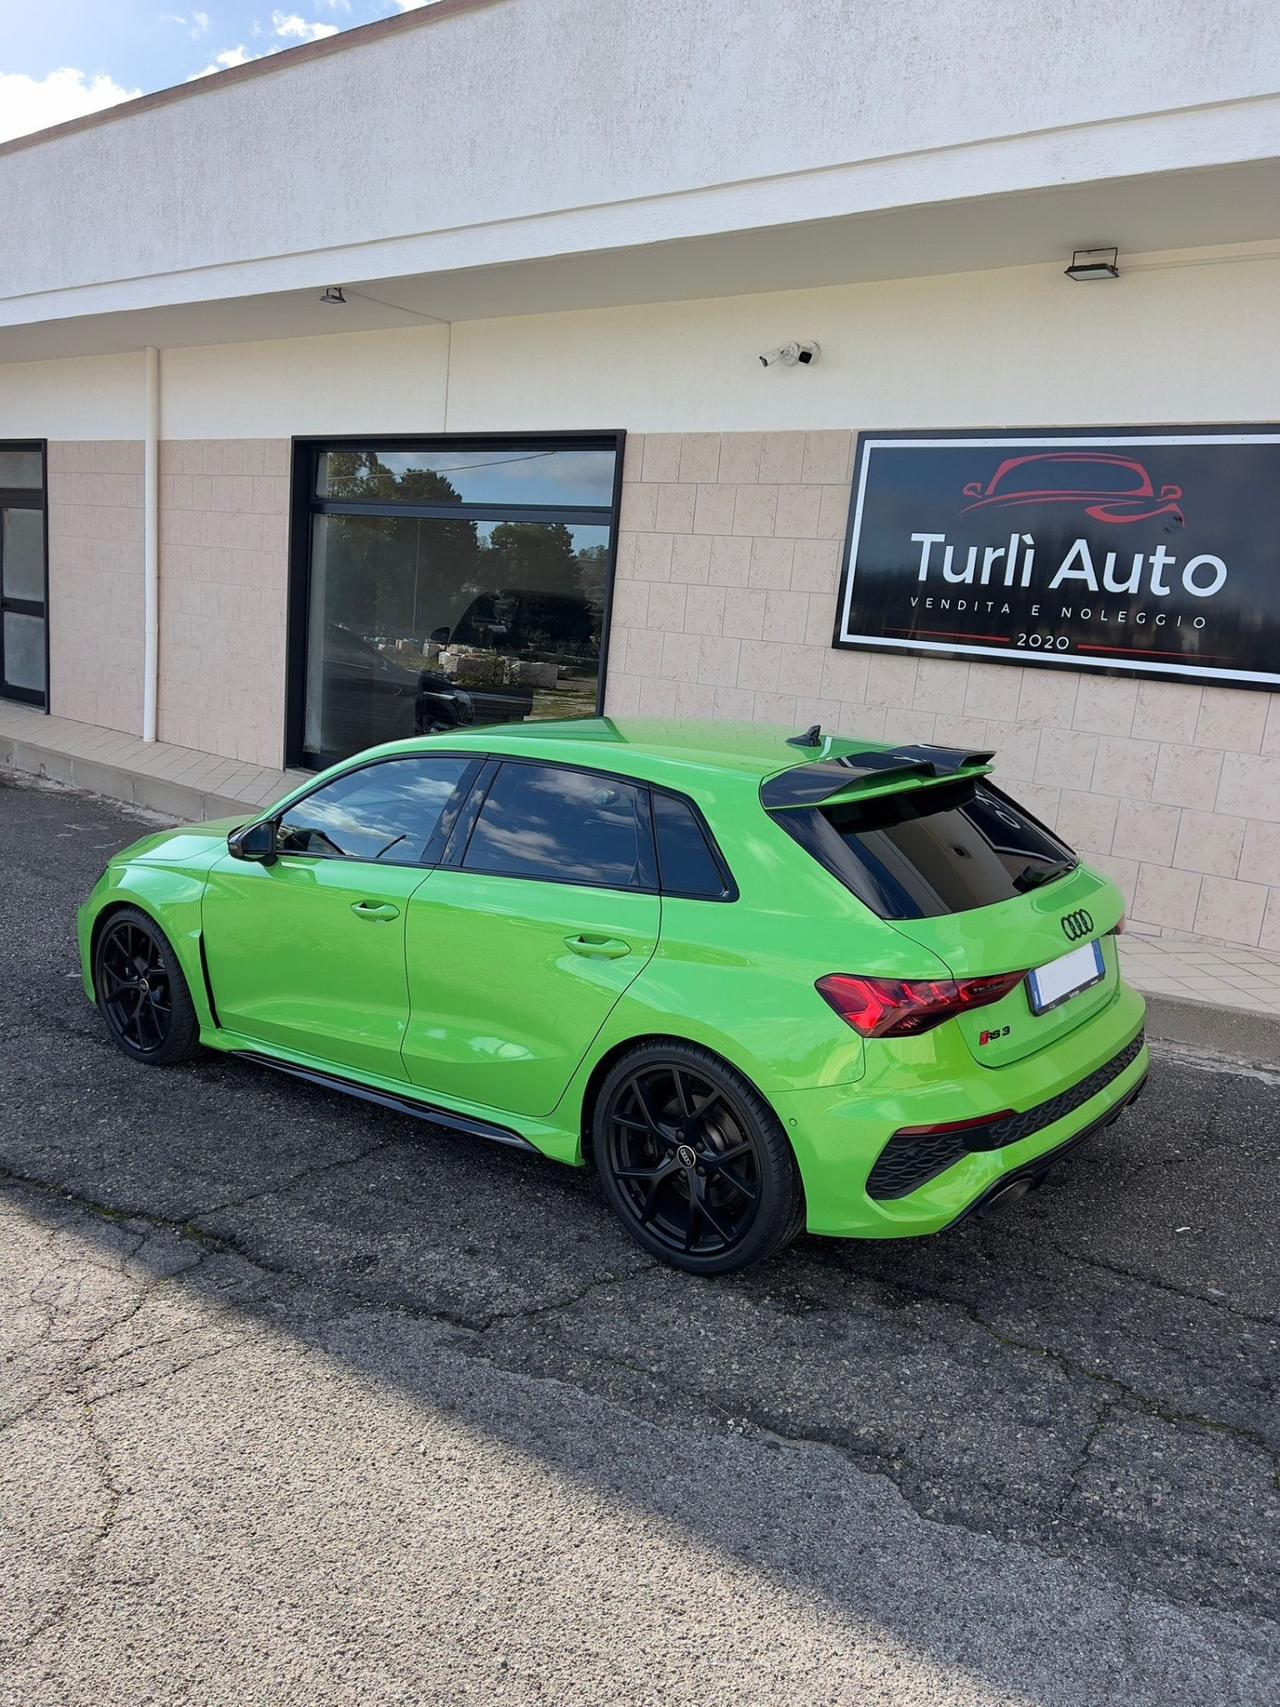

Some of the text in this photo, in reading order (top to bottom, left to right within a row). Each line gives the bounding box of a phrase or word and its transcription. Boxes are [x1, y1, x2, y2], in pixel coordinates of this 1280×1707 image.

[910, 532, 1228, 597] Turlì Auto
[910, 597, 1206, 629] VENDITA E NOLEGGIO
[1016, 632, 1070, 651] 2020
[1002, 1025, 1010, 1036] 3
